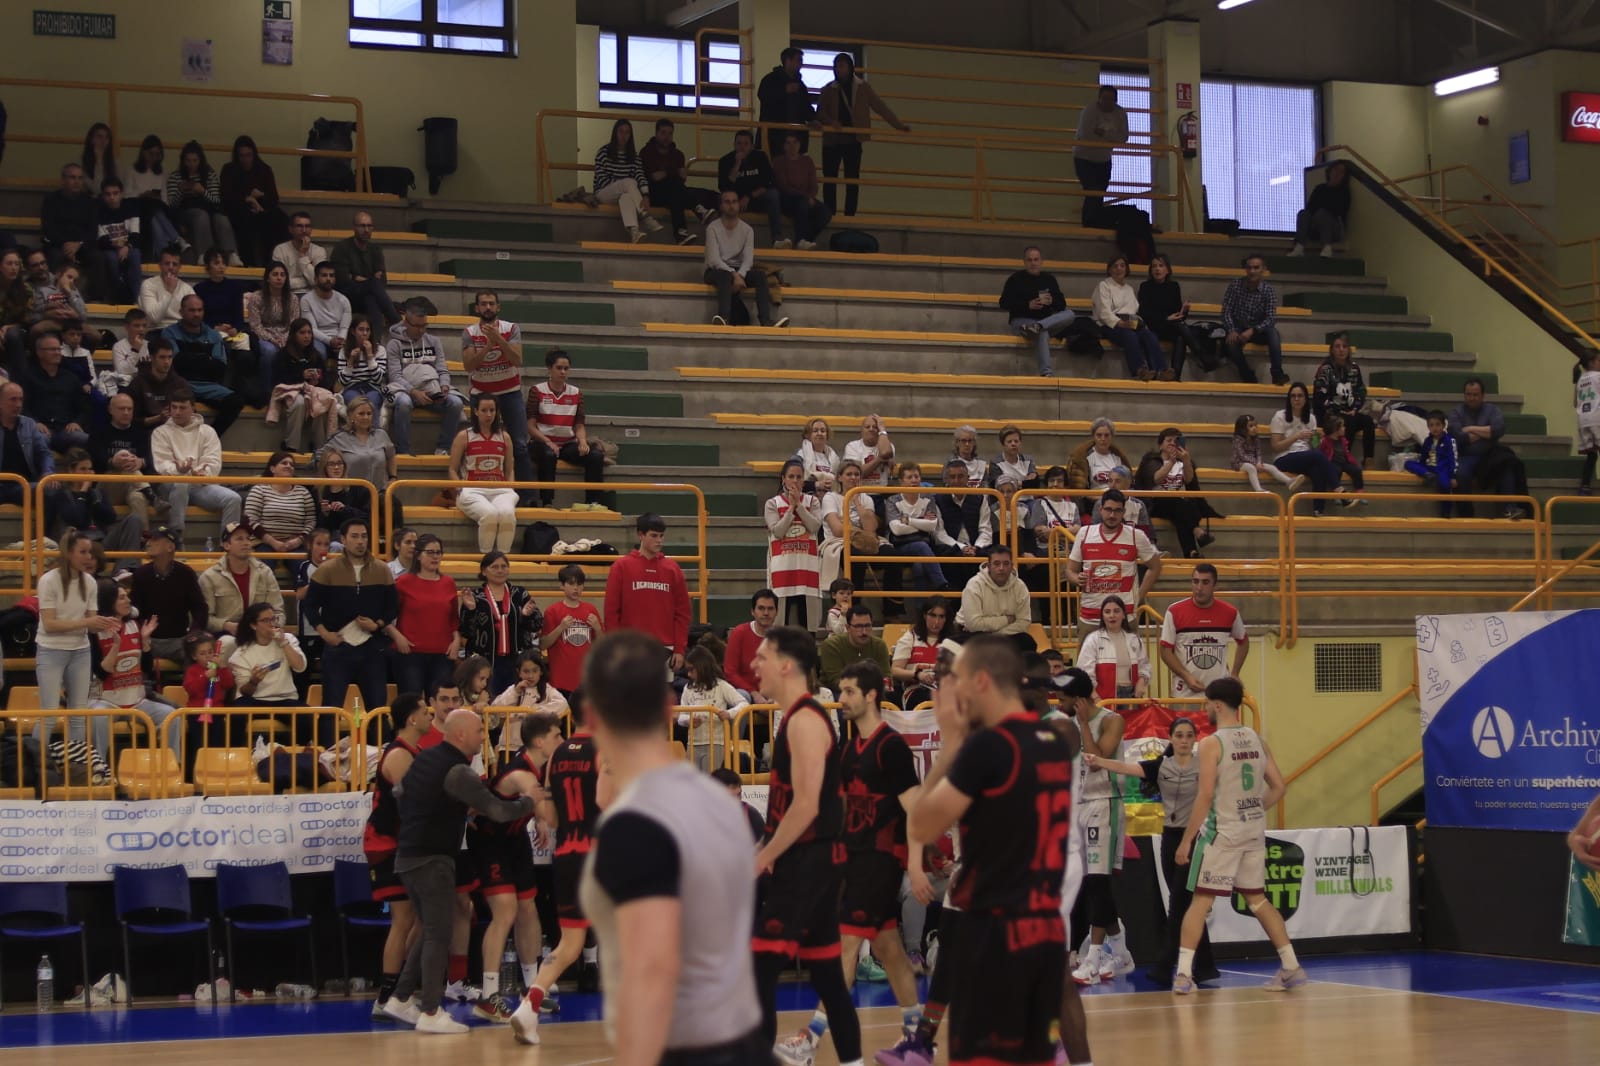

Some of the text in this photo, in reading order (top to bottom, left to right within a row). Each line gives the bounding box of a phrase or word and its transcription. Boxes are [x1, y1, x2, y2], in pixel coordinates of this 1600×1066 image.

[36, 14, 113, 35] PROHIBIDO FUMAR
[1231, 751, 1260, 761] GARRIDO
[1241, 762, 1255, 791] 6
[1436, 775, 1494, 789] Conviértete
[1497, 778, 1513, 788] en
[1514, 778, 1530, 788] un
[563, 777, 585, 822] 11
[1475, 801, 1483, 809] tu
[1484, 801, 1507, 811] poder
[1540, 802, 1570, 810] nuestra
[1571, 801, 1595, 813] gest
[1030, 791, 1071, 871] 12
[1314, 855, 1370, 866] VINTAGE
[489, 863, 502, 880] 2
[1314, 867, 1348, 877] WINE
